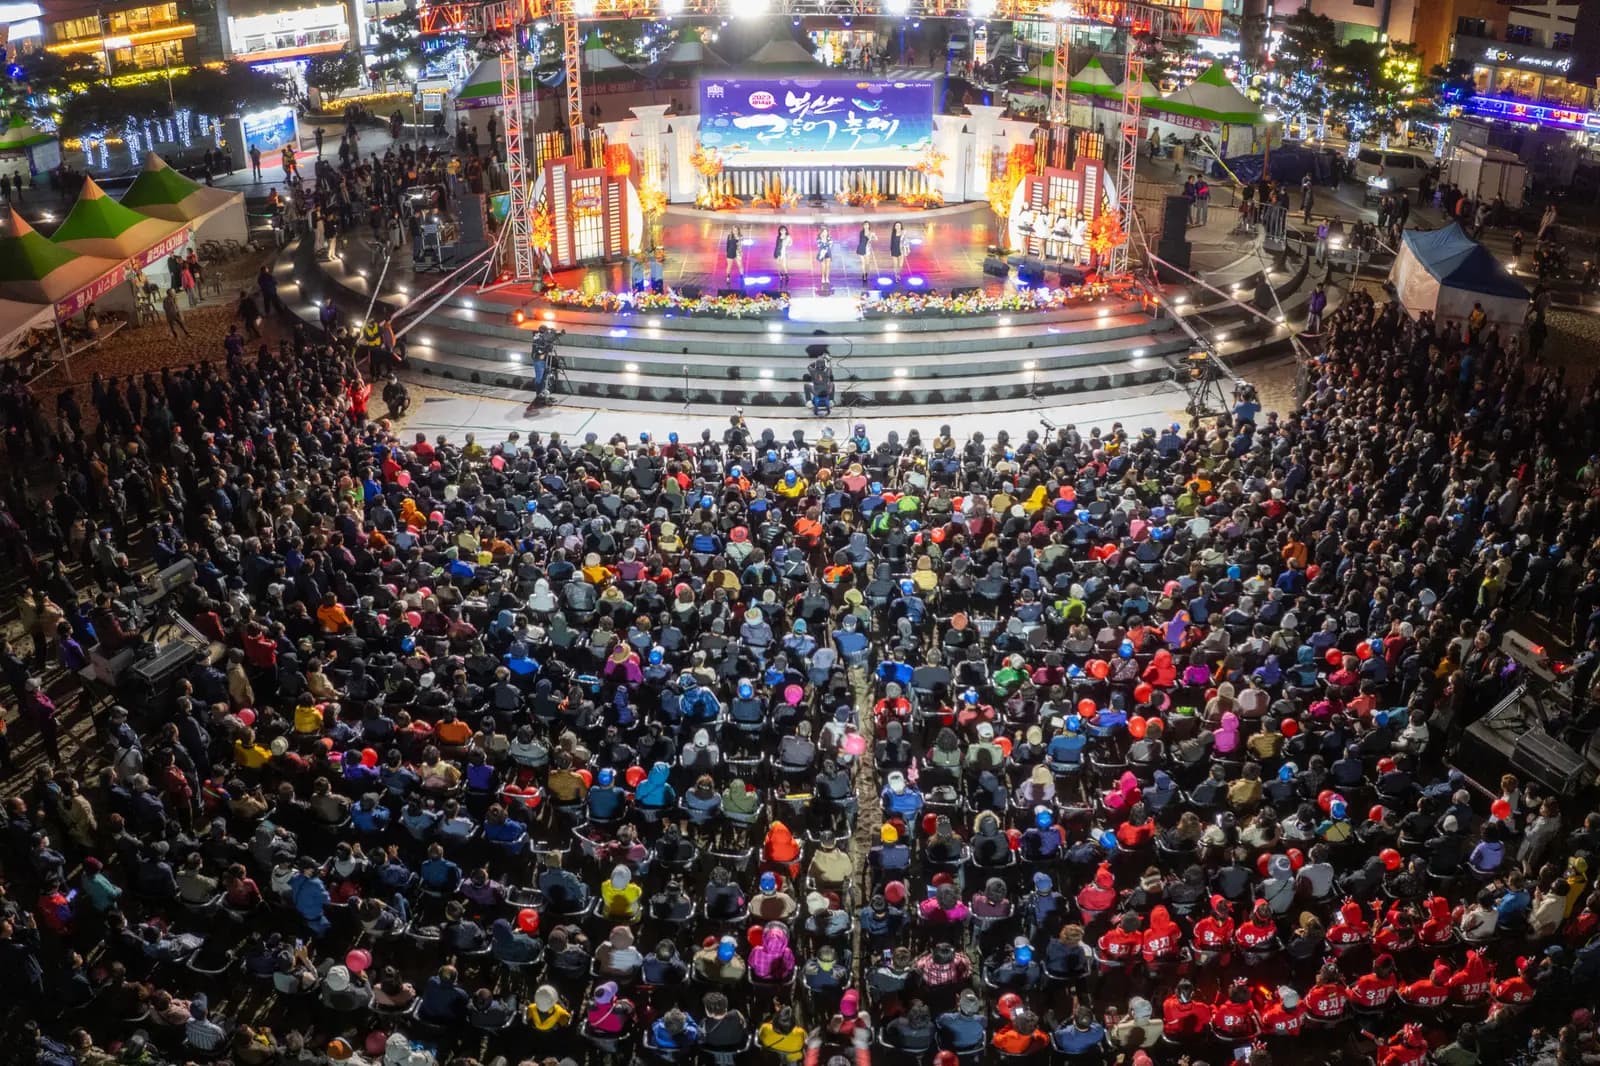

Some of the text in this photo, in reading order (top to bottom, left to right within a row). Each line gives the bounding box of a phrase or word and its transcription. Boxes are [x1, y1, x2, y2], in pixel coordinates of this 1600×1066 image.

[785, 90, 845, 118] 부산
[733, 110, 899, 150] 고등어 축제
[166, 232, 184, 251] 대기실
[76, 271, 118, 308] 행사 시스템
